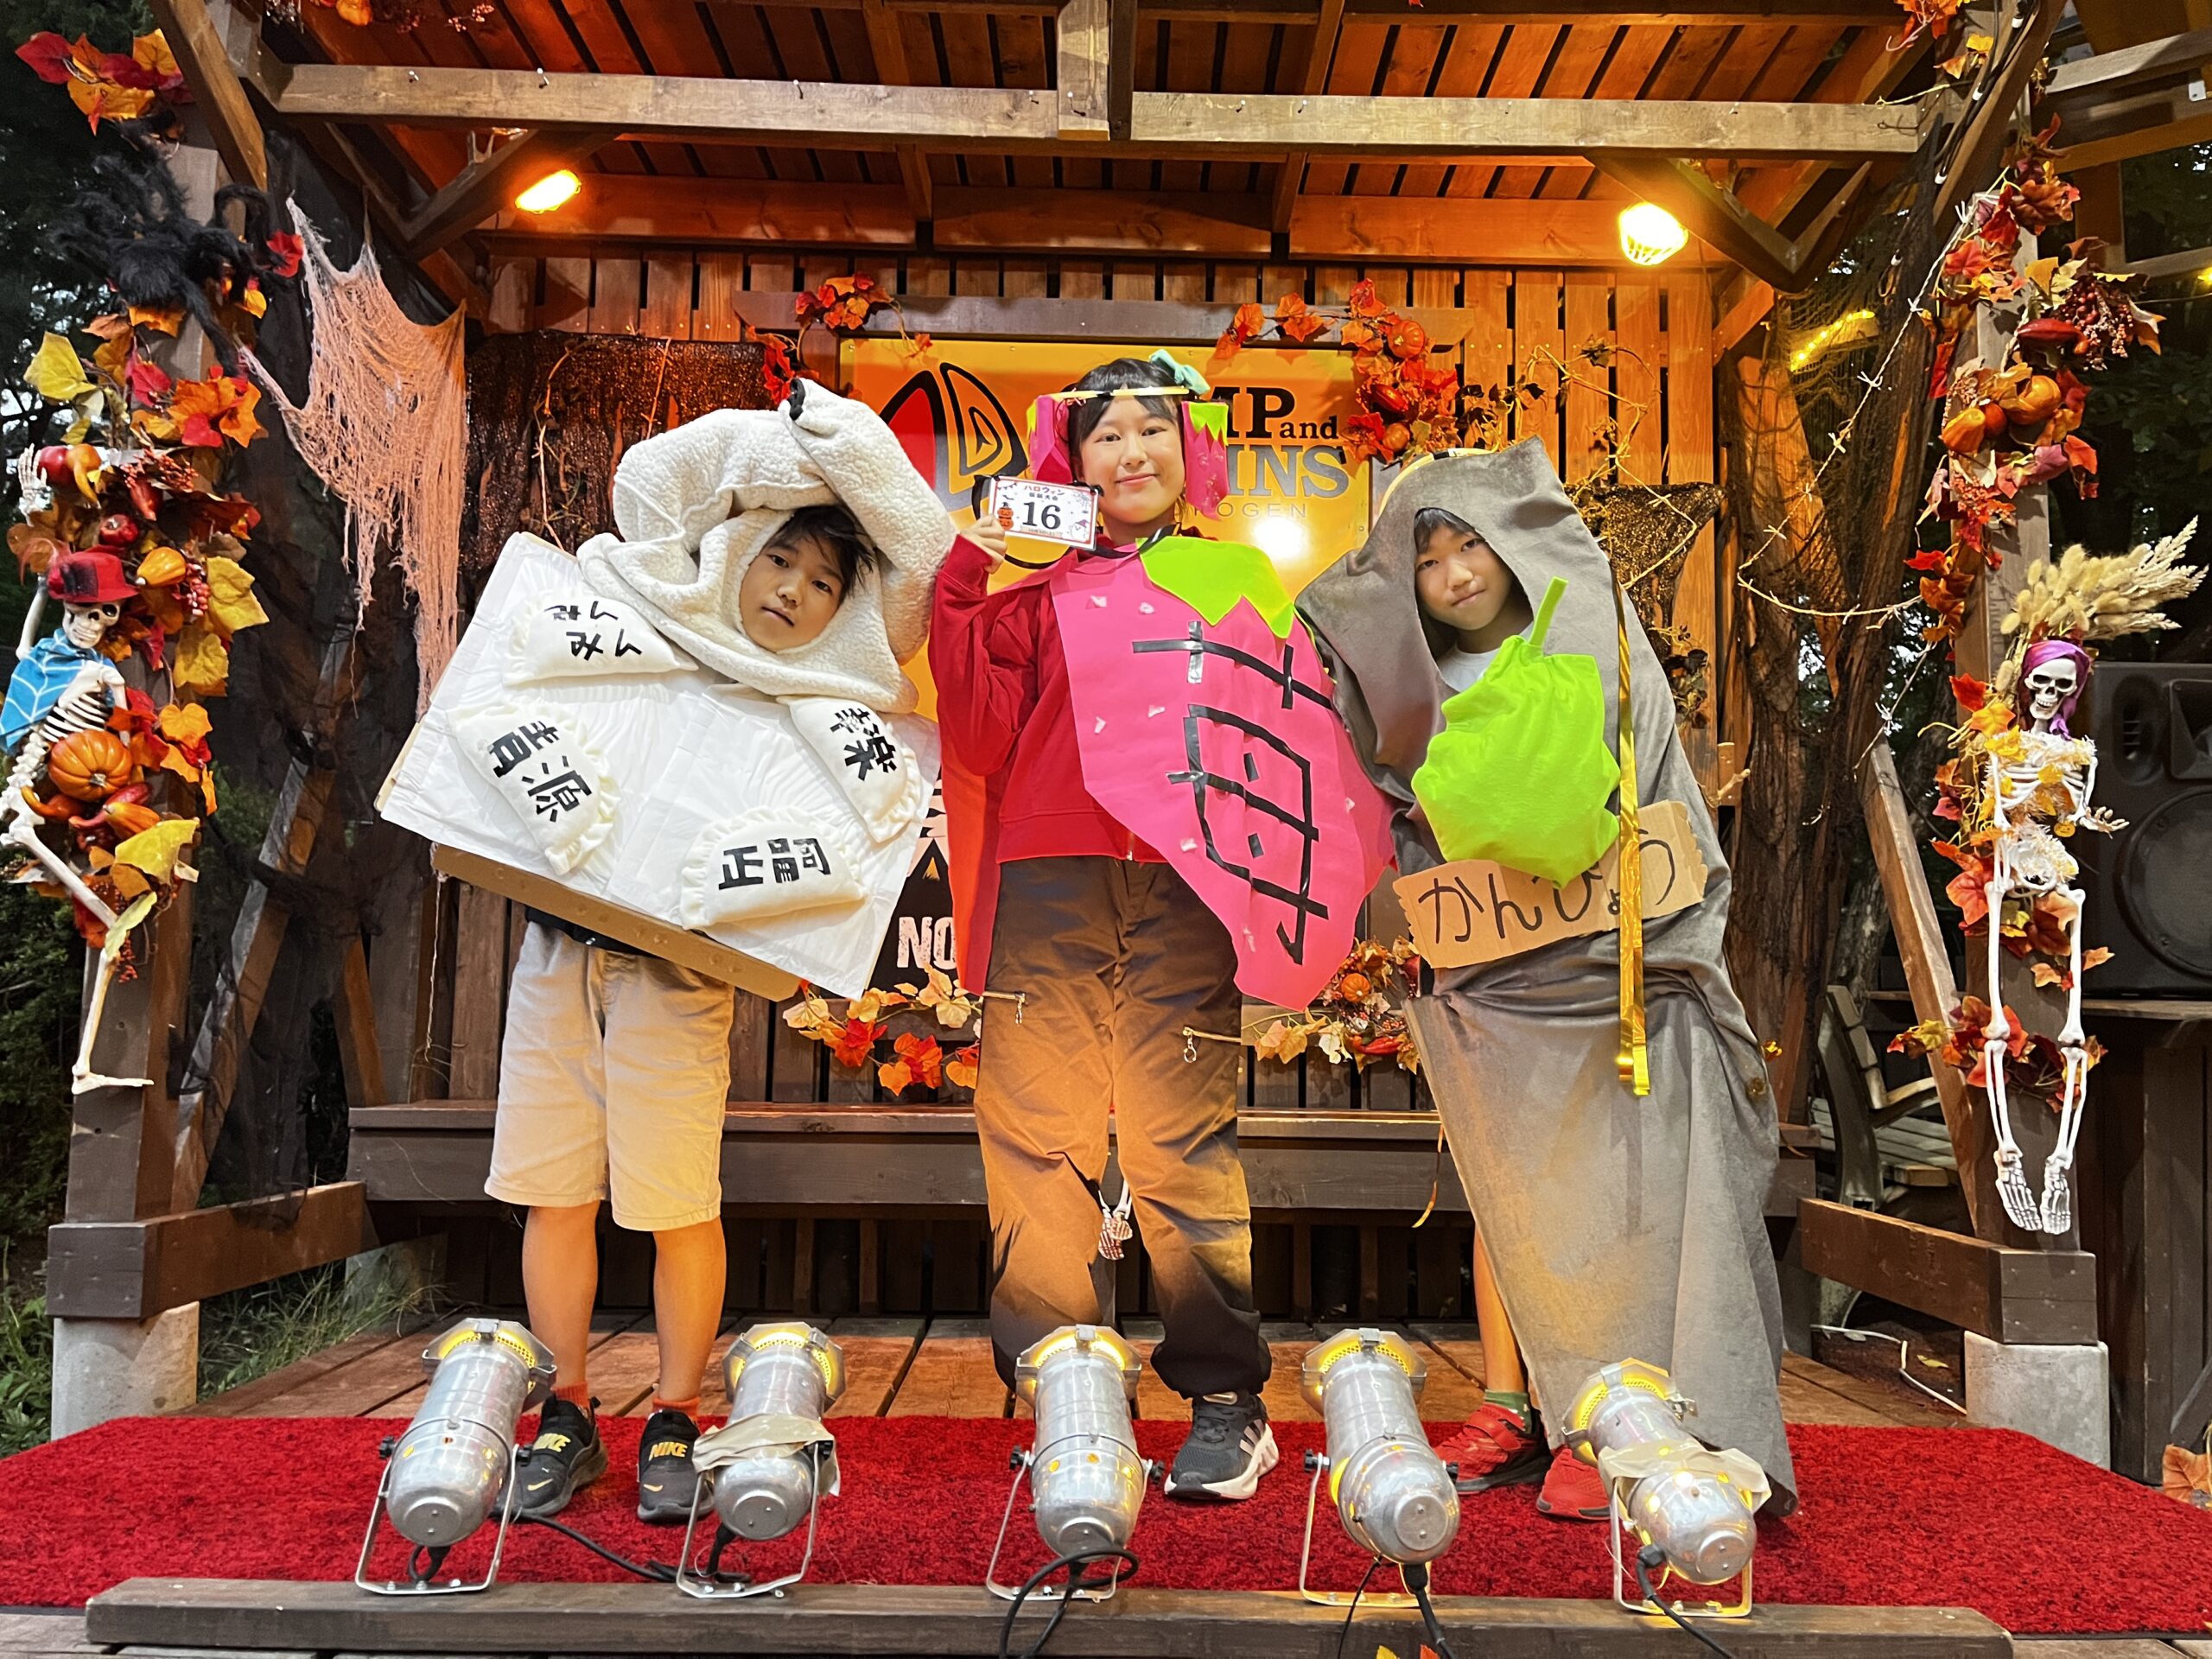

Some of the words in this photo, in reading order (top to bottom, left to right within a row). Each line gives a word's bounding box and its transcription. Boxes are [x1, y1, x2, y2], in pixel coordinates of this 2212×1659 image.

[1279, 416, 1339, 440] and
[1024, 485, 1065, 496] ハロウィン
[1022, 501, 1061, 530] 16
[649, 1441, 689, 1461] NIKE
